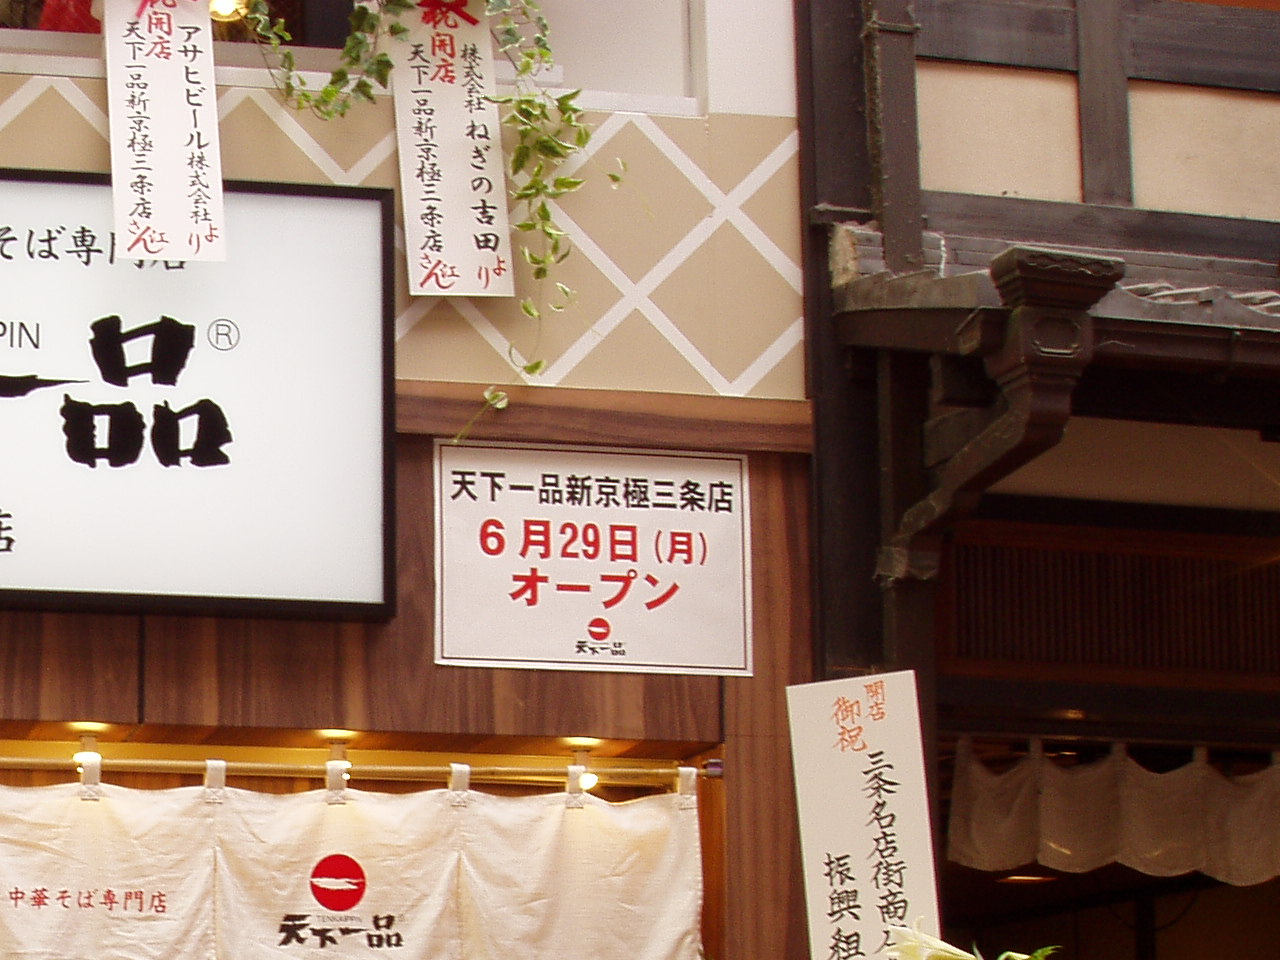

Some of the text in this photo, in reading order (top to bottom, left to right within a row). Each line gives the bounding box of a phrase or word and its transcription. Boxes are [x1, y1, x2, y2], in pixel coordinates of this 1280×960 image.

[121, 20, 155, 220] 天下一品新京極三条店
[176, 24, 213, 224] アサヒビール株式会社
[406, 43, 446, 254] 天下一品新京極三条店
[459, 43, 502, 253] 株式会社ねぎの吉田
[450, 470, 734, 513] 天下一品新京極三条店
[508, 567, 680, 610] オープン
[575, 640, 627, 656] 天下一品
[831, 696, 869, 753] 御祝
[8, 886, 167, 913] 中華そば専門店
[277, 913, 404, 949] 天下一品
